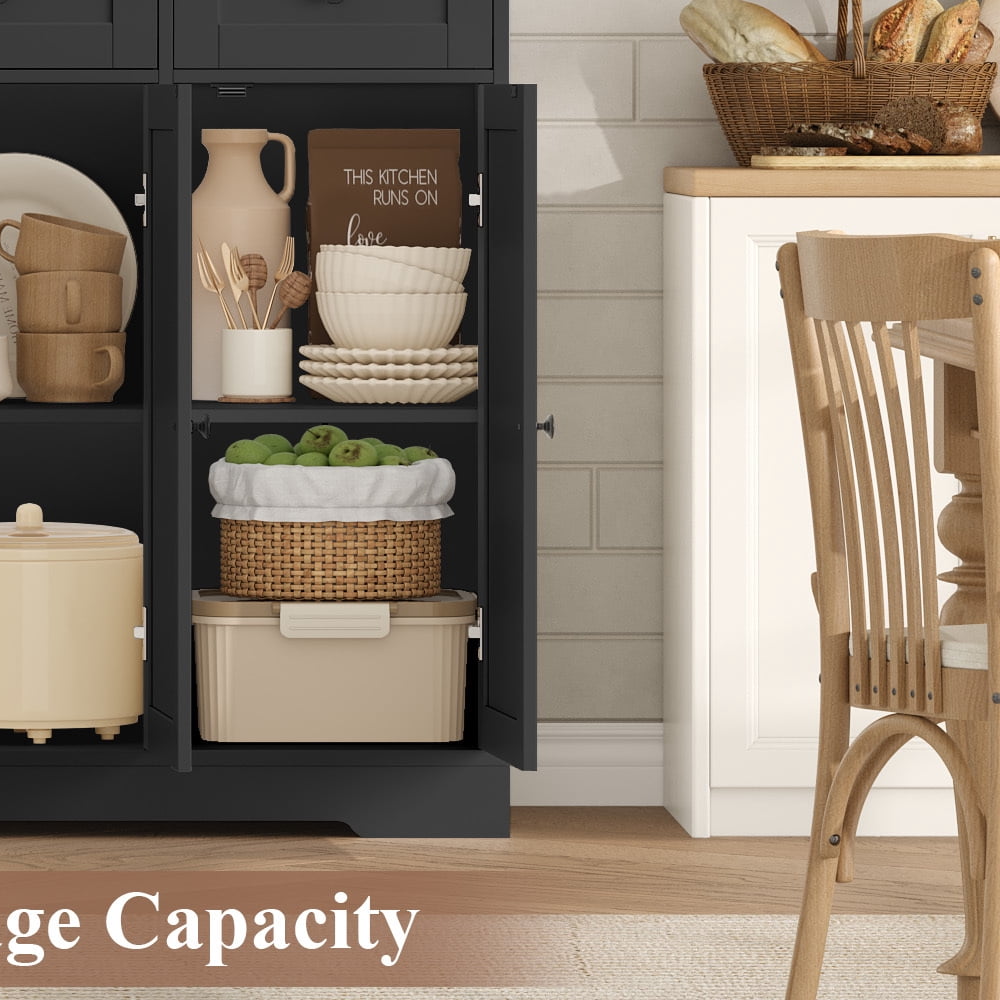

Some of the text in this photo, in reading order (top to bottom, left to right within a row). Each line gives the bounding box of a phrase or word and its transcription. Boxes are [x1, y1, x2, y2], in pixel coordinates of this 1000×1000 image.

[343, 168, 438, 185] THIS KITCHEN
[373, 189, 438, 206] RUNS ON
[346, 213, 388, 246] love
